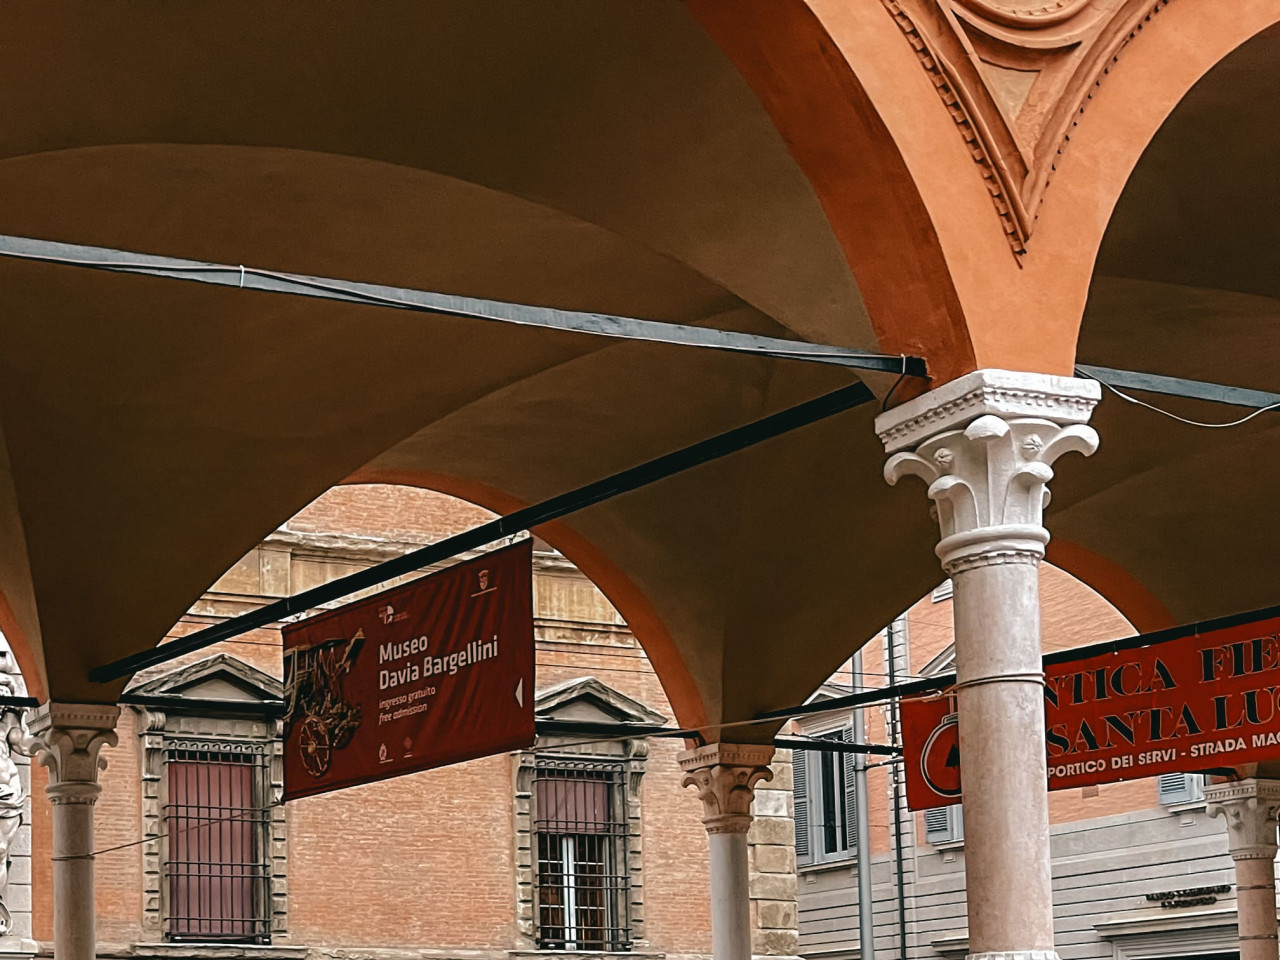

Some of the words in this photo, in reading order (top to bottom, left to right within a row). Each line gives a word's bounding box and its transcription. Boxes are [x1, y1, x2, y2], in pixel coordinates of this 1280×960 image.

[379, 635, 428, 665] Museo
[379, 662, 419, 690] Davia
[423, 634, 498, 676] Bargellini
[1044, 657, 1180, 710] NTICA
[1196, 632, 1280, 683] FIE
[378, 712, 392, 726] free
[393, 703, 428, 720] admission
[379, 694, 407, 710] ingresso
[408, 686, 436, 704] gratuito
[1045, 701, 1205, 759] SANTA
[1210, 684, 1280, 732] LU
[1048, 759, 1106, 778] PORTICO
[1111, 754, 1133, 769] DEI
[1138, 748, 1176, 765] SERVI
[1190, 737, 1247, 758] STRADA
